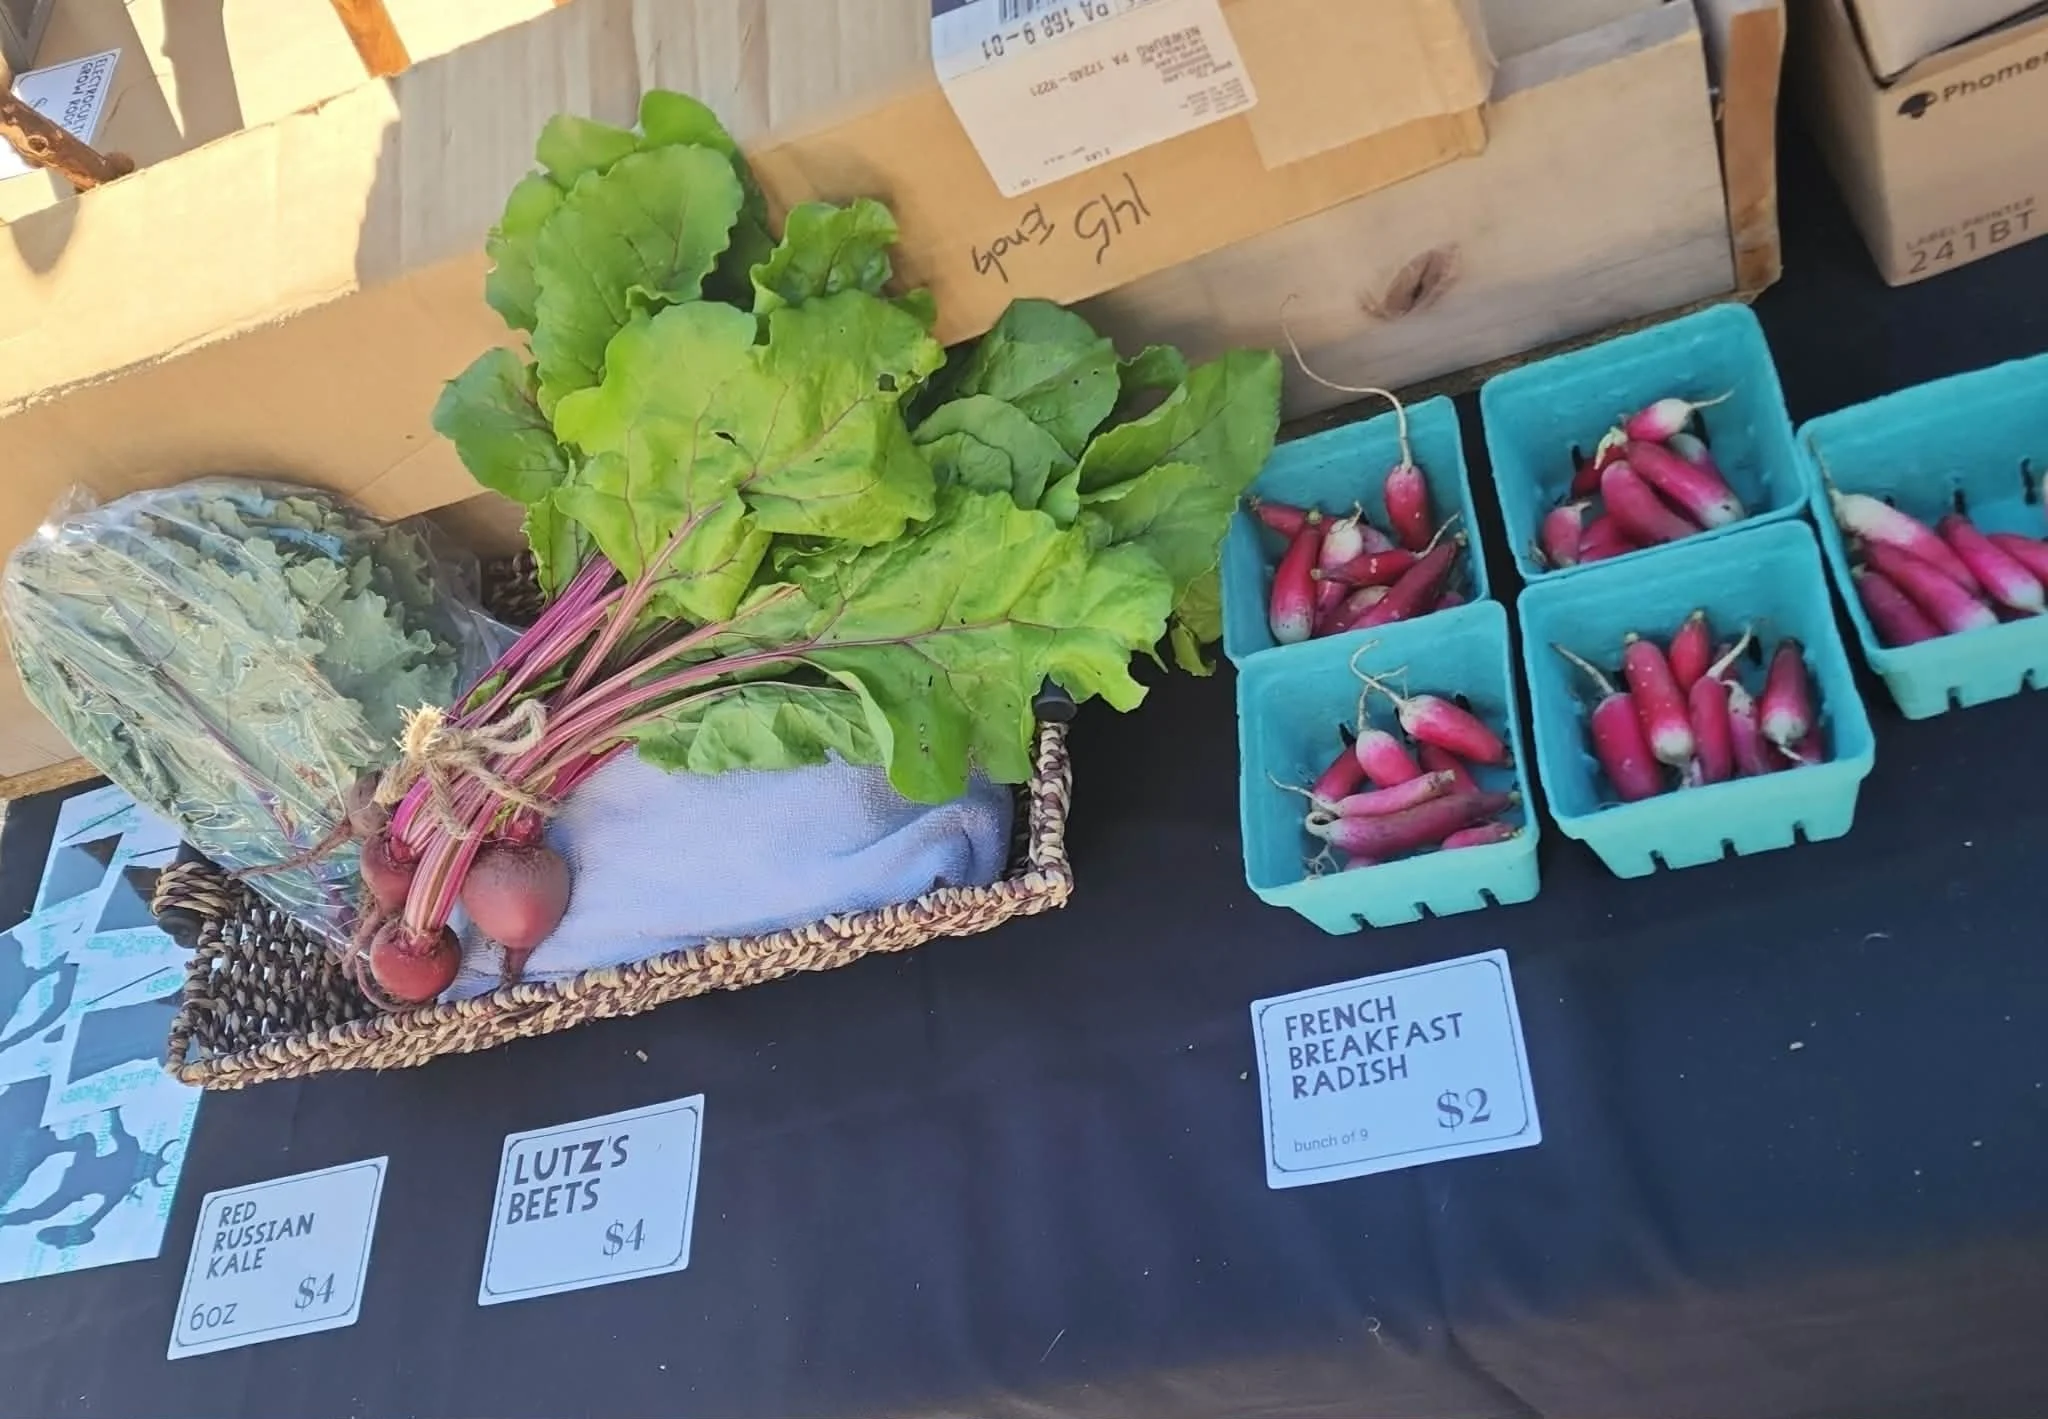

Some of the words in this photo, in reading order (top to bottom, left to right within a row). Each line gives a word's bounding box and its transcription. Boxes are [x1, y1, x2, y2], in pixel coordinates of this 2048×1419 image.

[1074, 172, 1151, 264] 145
[1285, 996, 1396, 1041] FRENCH
[1289, 1012, 1463, 1070] BREAKFAST
[1292, 1054, 1408, 1100] RADISH
[1436, 1086, 1491, 1132] $2
[514, 1134, 629, 1186] LUTZ'S
[1294, 1134, 1337, 1153] bunch
[1342, 1128, 1356, 1145] of
[1360, 1127, 1369, 1142] 9
[218, 1200, 257, 1228] RED
[506, 1178, 601, 1225] BEETS
[212, 1212, 315, 1254] RUSSIAN
[602, 1217, 646, 1260] $4
[205, 1247, 266, 1280] KALE
[294, 1272, 336, 1312] $4
